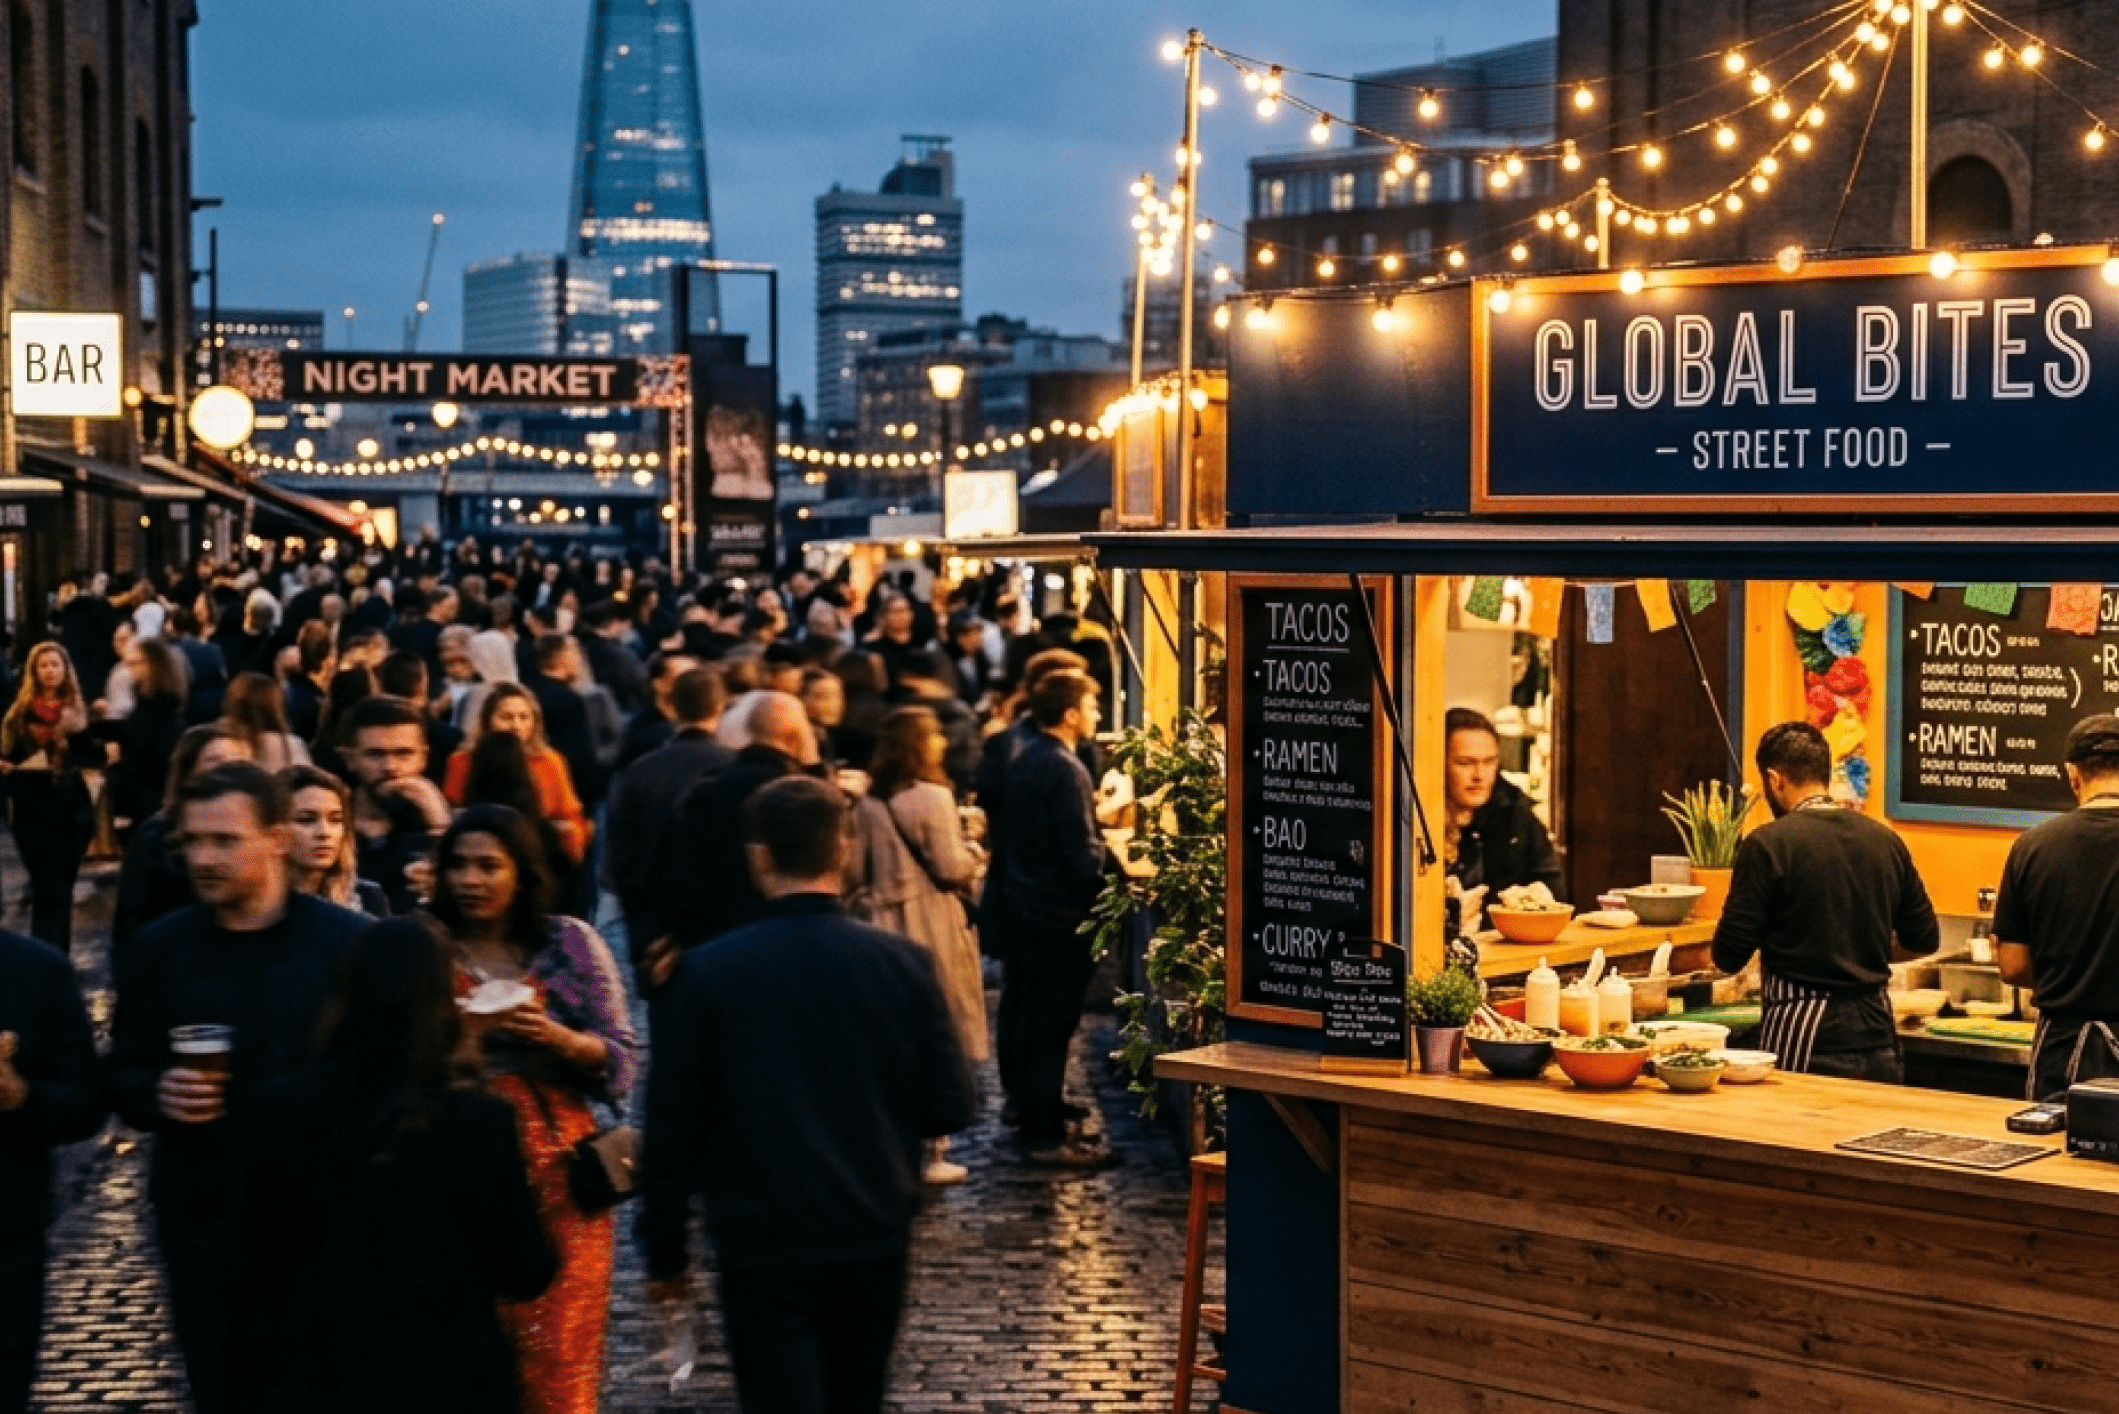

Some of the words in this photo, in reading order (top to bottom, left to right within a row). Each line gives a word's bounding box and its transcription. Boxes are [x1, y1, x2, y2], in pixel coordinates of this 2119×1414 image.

[25, 342, 104, 385] BAR
[1534, 310, 1817, 411] GLOBAL
[1855, 294, 2093, 402] BITES
[303, 361, 433, 394] NIGHT
[447, 363, 618, 397] MARKET
[1693, 428, 1811, 469] STREET
[1824, 426, 1909, 468] FOOD
[1264, 602, 1350, 642] TACOS
[1920, 622, 2001, 656] TACOS
[1262, 659, 1332, 694] TACOS
[1263, 737, 1339, 774] RAMEN
[1919, 722, 1997, 757] RAMEN
[1263, 815, 1307, 850] BAO
[1262, 922, 1332, 958] CURRY
